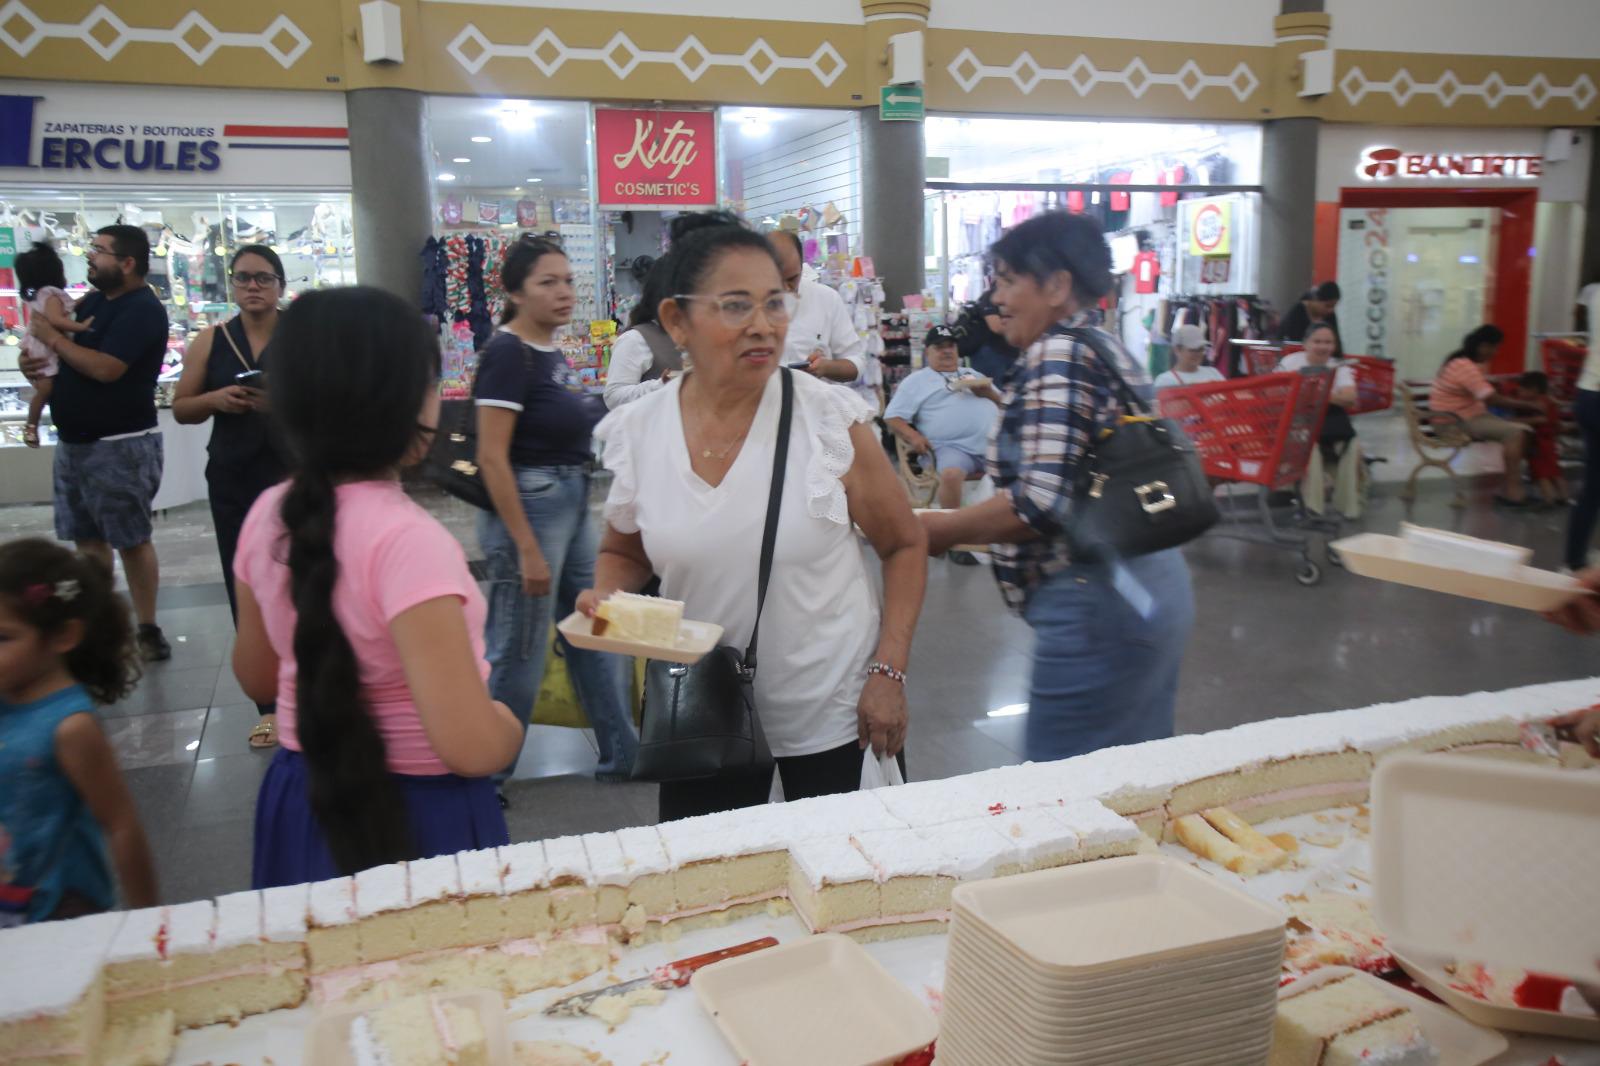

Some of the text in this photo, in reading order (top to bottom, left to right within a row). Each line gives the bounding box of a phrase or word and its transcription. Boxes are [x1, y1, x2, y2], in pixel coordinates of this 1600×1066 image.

[44, 122, 215, 138] ZAPATERIAS Y BOUTIQUES
[613, 118, 699, 180] Kity
[614, 182, 701, 196] COSMETIC'S
